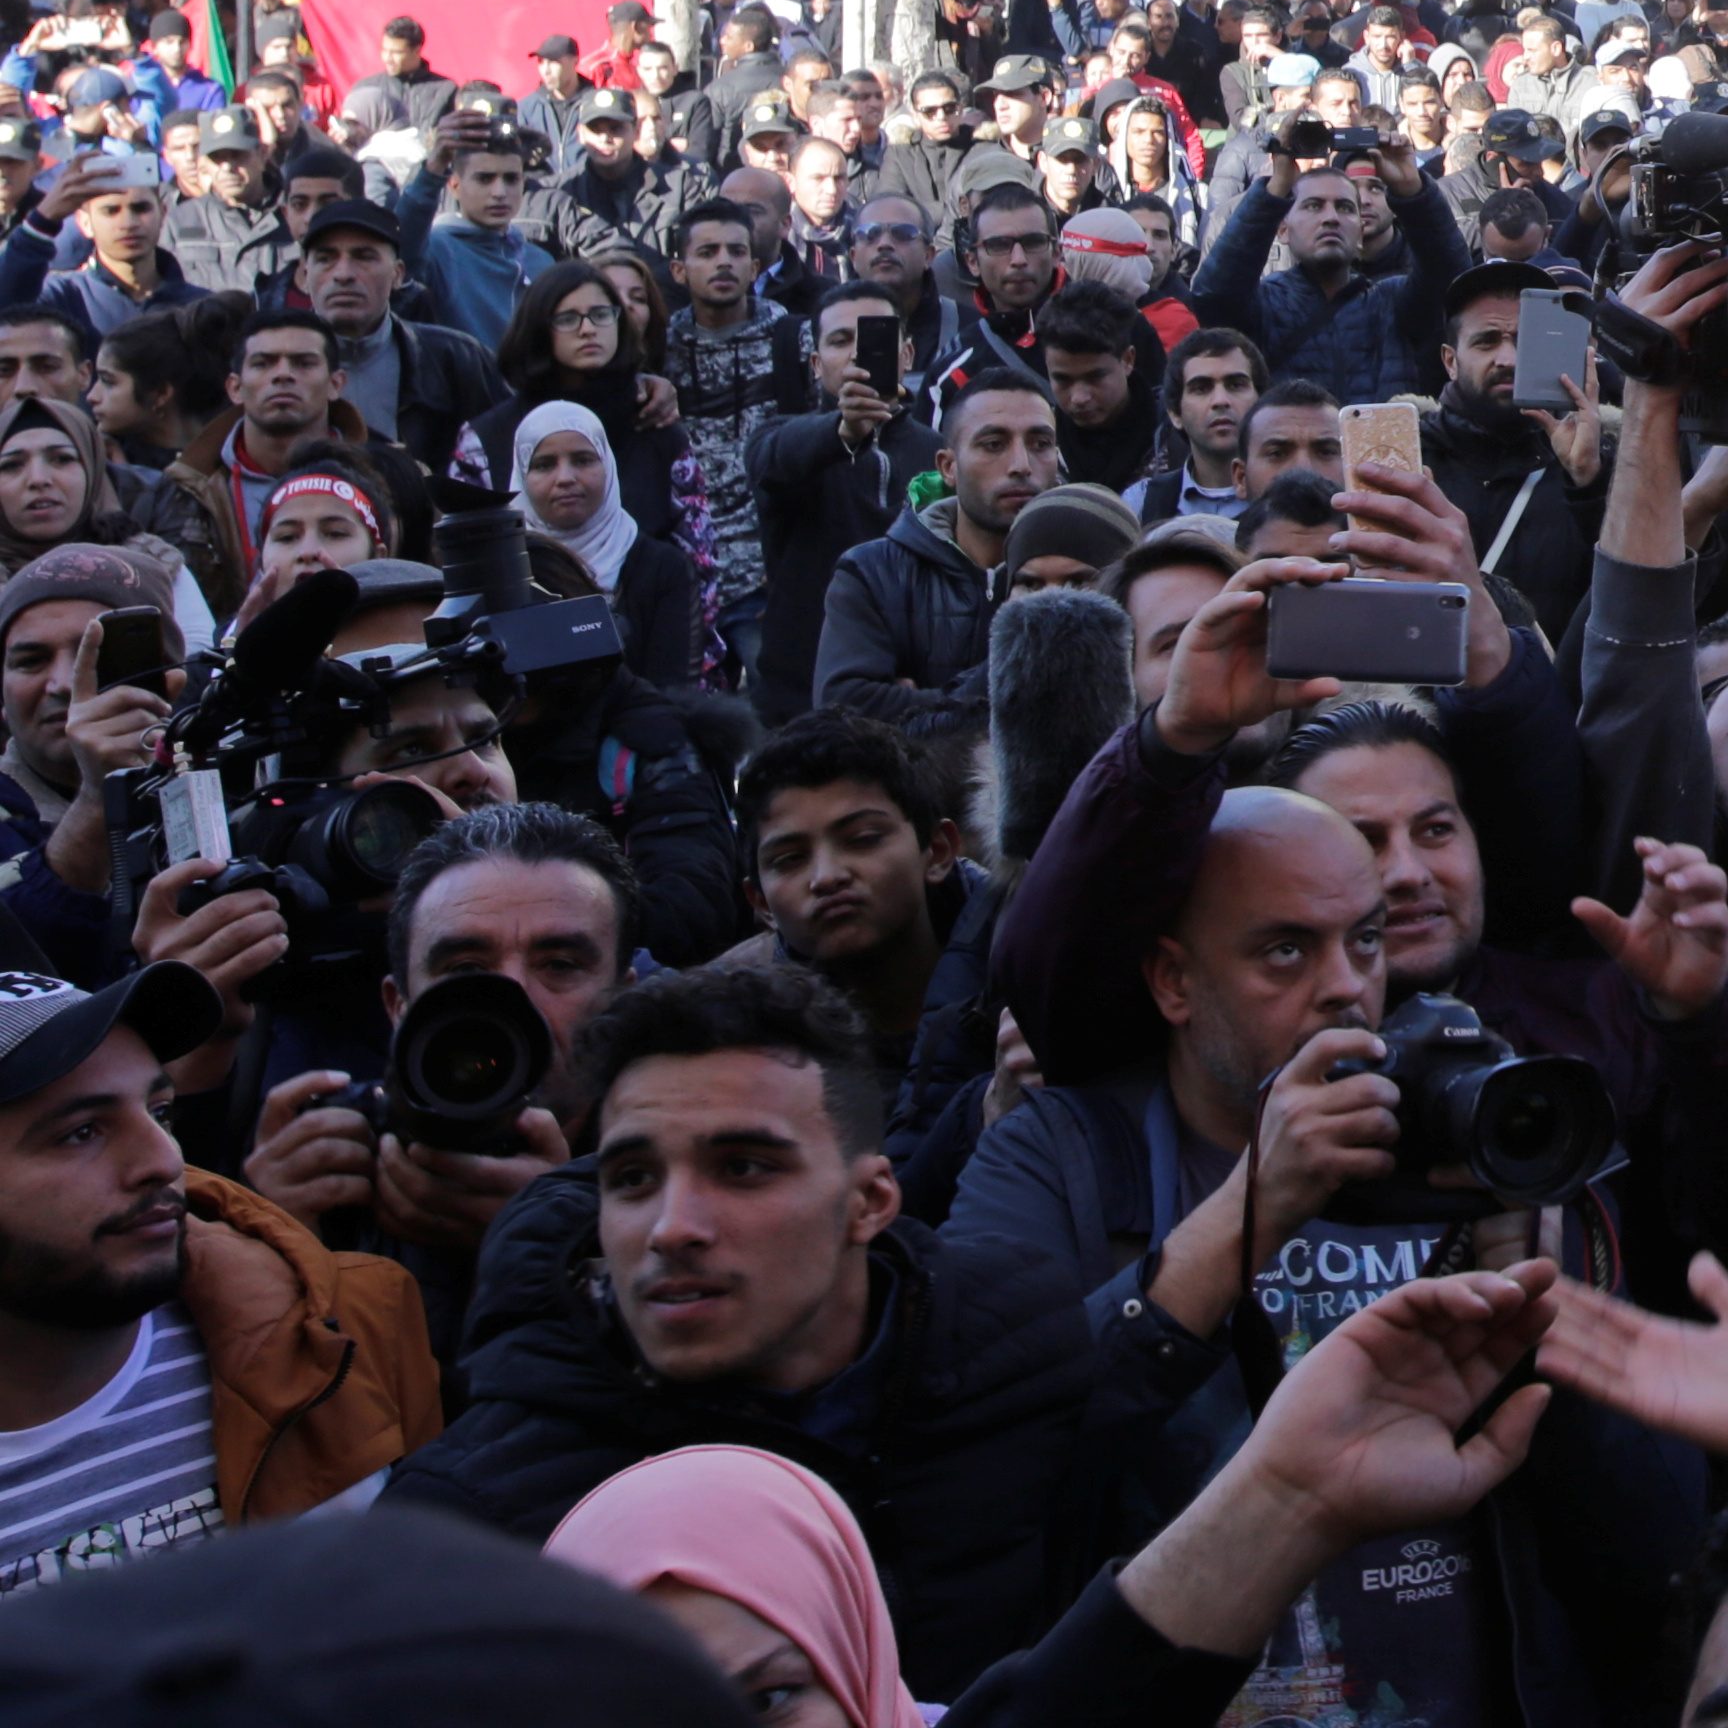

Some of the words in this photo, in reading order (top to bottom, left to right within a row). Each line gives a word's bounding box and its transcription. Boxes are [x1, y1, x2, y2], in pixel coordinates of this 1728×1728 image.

[287, 477, 333, 495] TUNISIE
[571, 621, 602, 633] SONY
[1444, 1026, 1480, 1037] Canon
[1401, 1540, 1441, 1559] UEFA
[1396, 1581, 1455, 1605] FRANCE
